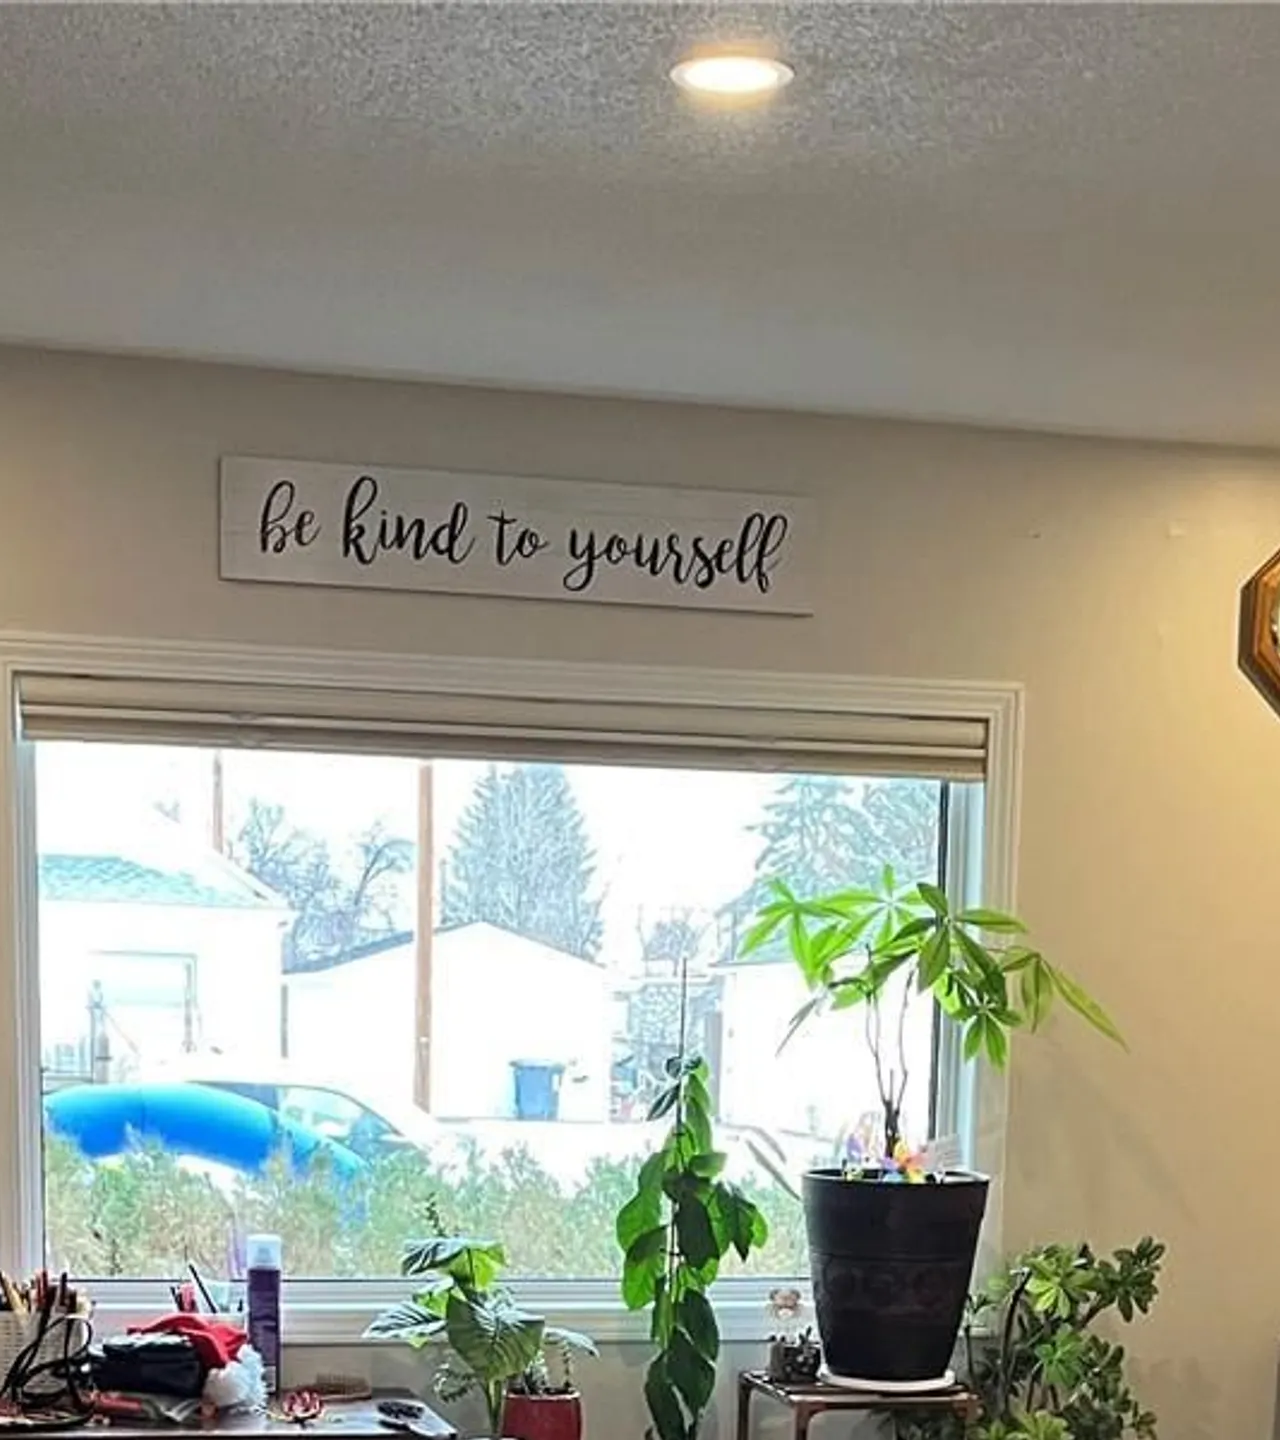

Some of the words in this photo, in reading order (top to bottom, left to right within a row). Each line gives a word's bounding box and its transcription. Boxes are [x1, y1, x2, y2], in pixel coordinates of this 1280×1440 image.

[260, 480, 321, 554] be
[341, 476, 476, 567] kind
[487, 509, 549, 567] to
[562, 512, 789, 594] yourself
